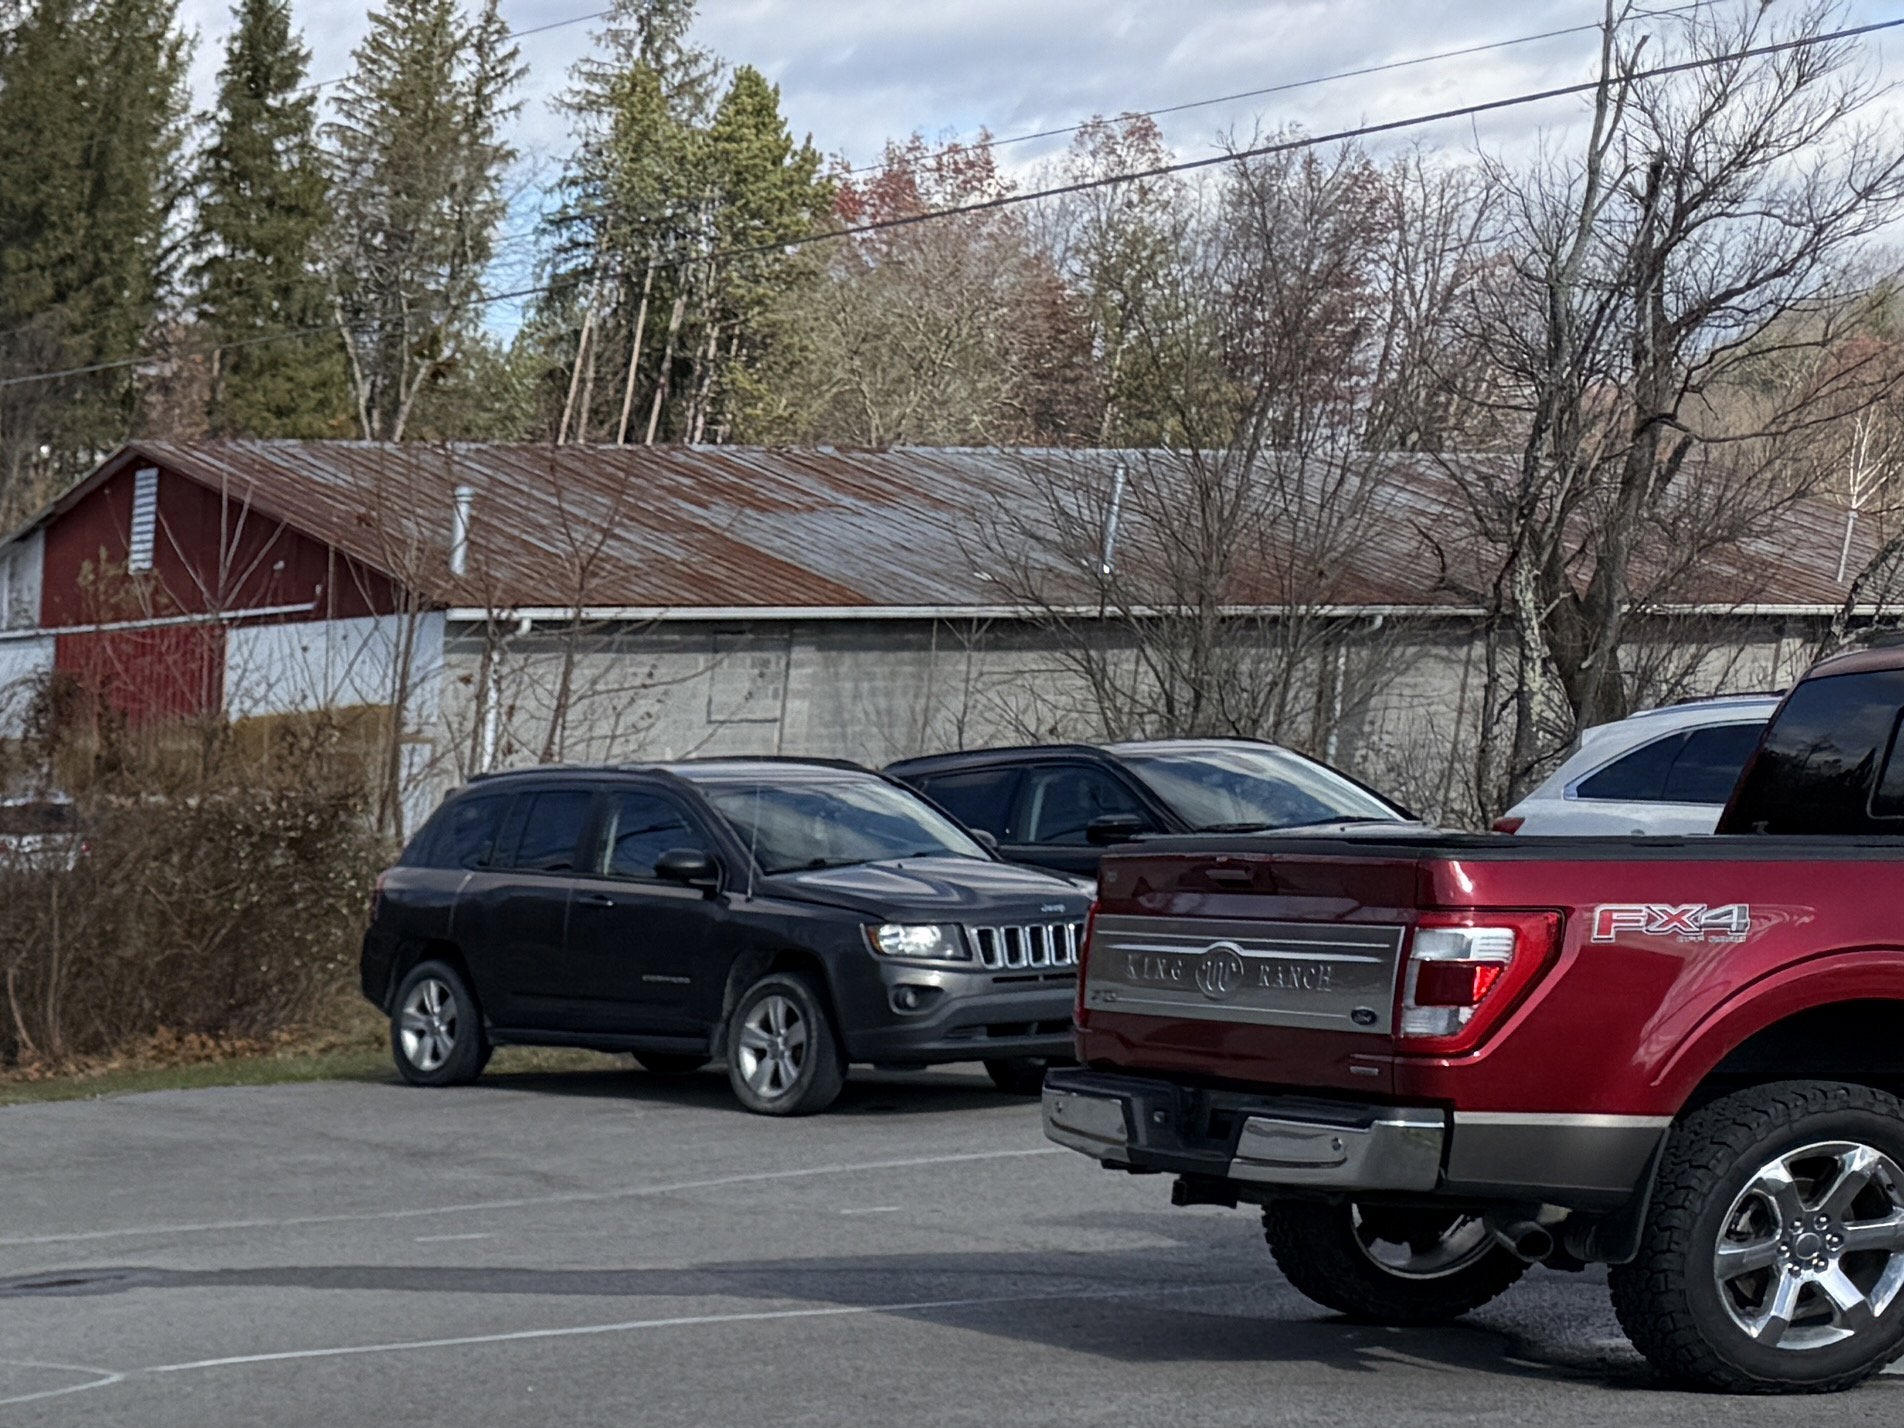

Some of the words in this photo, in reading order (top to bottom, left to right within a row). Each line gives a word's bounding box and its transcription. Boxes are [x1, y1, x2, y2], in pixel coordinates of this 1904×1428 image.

[1591, 903, 1750, 943] FX4
[1126, 953, 1183, 981] KING
[1258, 964, 1333, 991] RANCH
